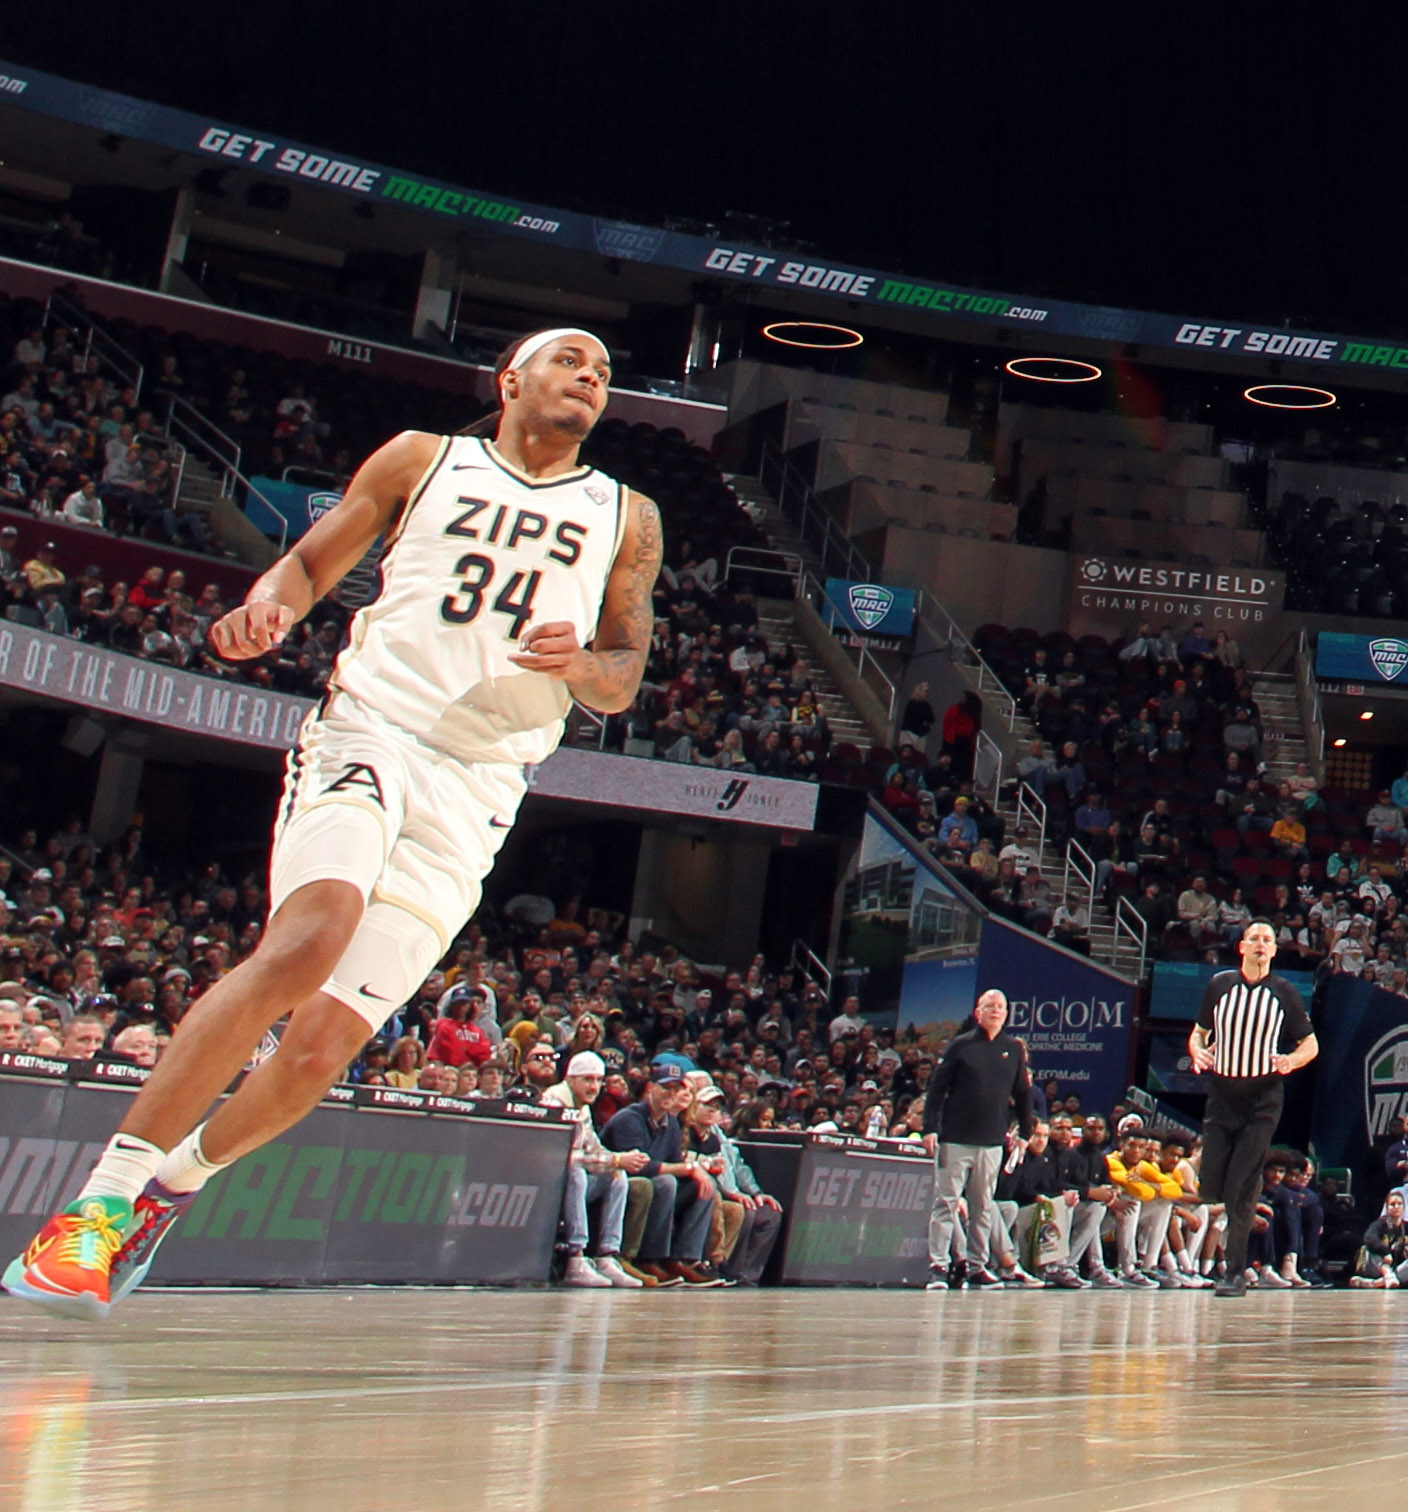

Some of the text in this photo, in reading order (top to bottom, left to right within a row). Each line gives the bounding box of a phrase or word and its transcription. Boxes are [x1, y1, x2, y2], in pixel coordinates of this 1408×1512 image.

[199, 128, 275, 162] GET
[275, 149, 381, 192] SOME
[705, 248, 775, 277] GET
[777, 261, 875, 297] SOME
[327, 339, 373, 364] M111
[1175, 324, 1242, 348] GET
[1243, 331, 1337, 361] SOME
[443, 495, 590, 568] ZIPS
[440, 553, 542, 643] 34
[1113, 565, 1267, 595] WESTFIELD
[852, 597, 888, 612] MAC
[1081, 594, 1265, 622] CHAMPIONS CLUB
[1372, 650, 1408, 665] MAC
[23, 639, 57, 685] OF
[68, 651, 116, 702] THE
[123, 667, 302, 742] MID-AMERIC
[805, 1167, 934, 1211] GET SOME
